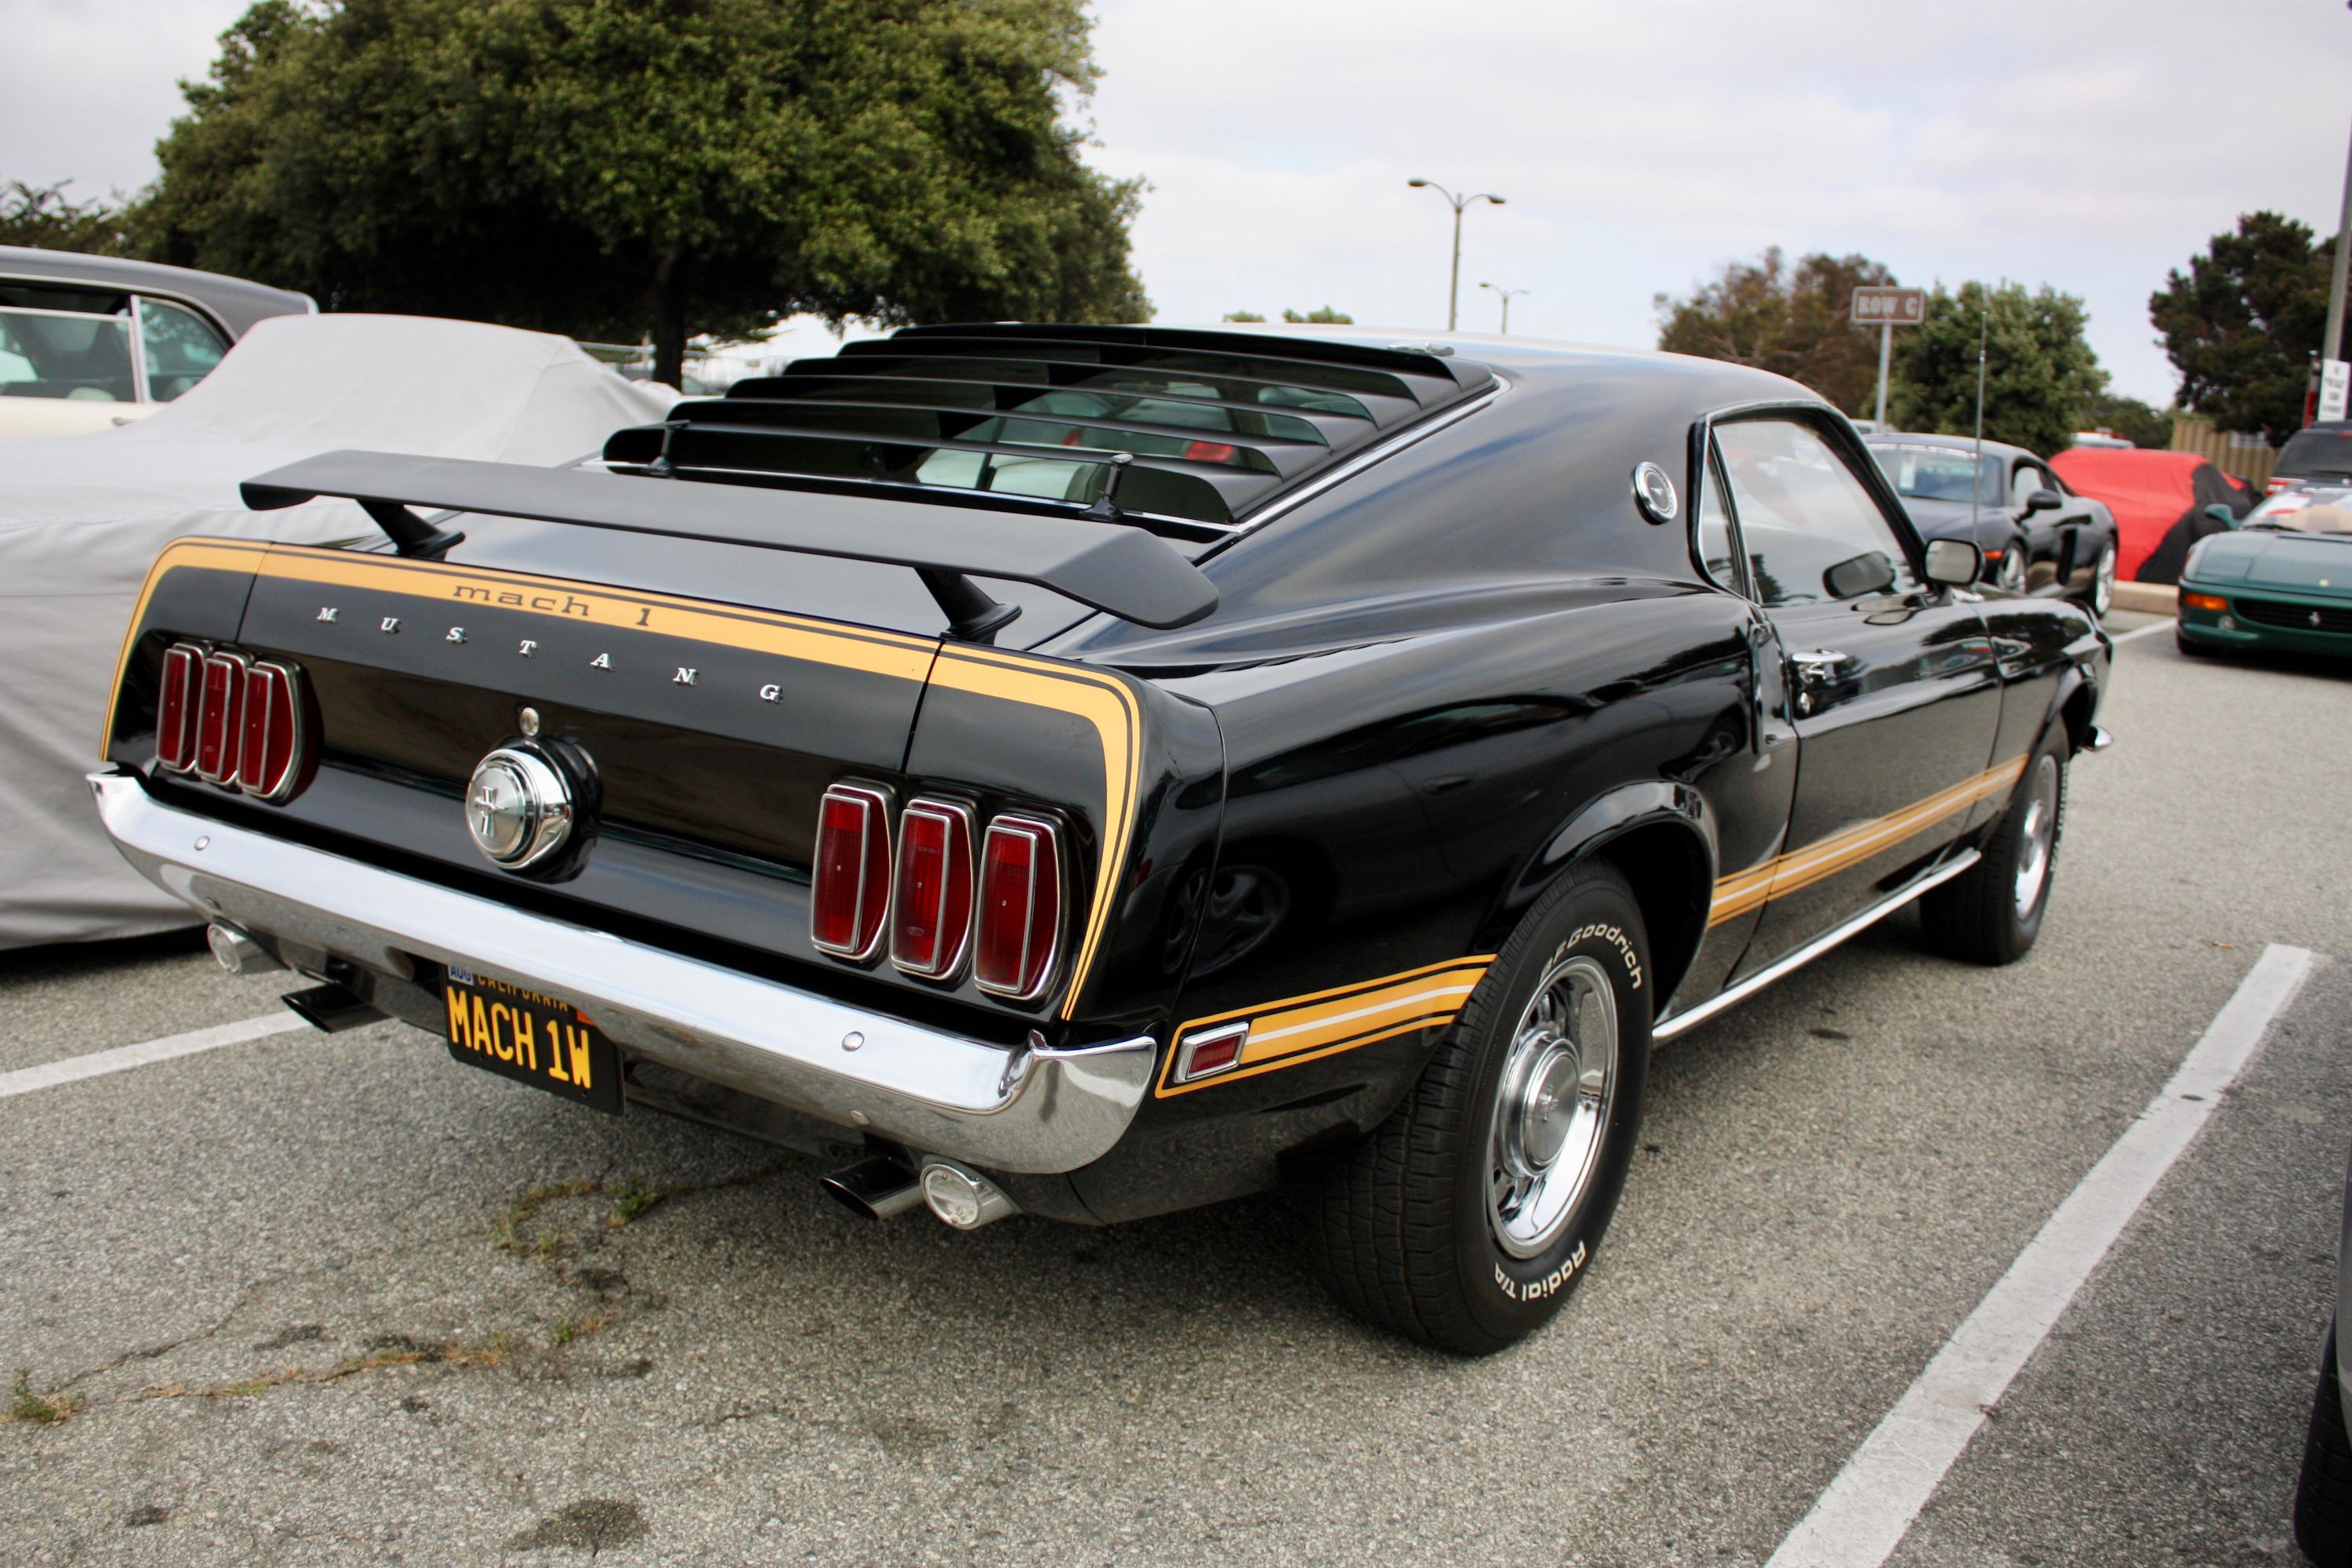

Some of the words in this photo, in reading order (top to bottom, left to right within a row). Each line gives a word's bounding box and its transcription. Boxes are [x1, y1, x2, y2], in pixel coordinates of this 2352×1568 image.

[453, 586, 589, 616] mach
[636, 608, 652, 626] 1
[316, 608, 783, 704] MUSTANG
[447, 985, 536, 1070] MACH
[546, 1020, 591, 1088] 1W
[1522, 1240, 1586, 1301] Radial
